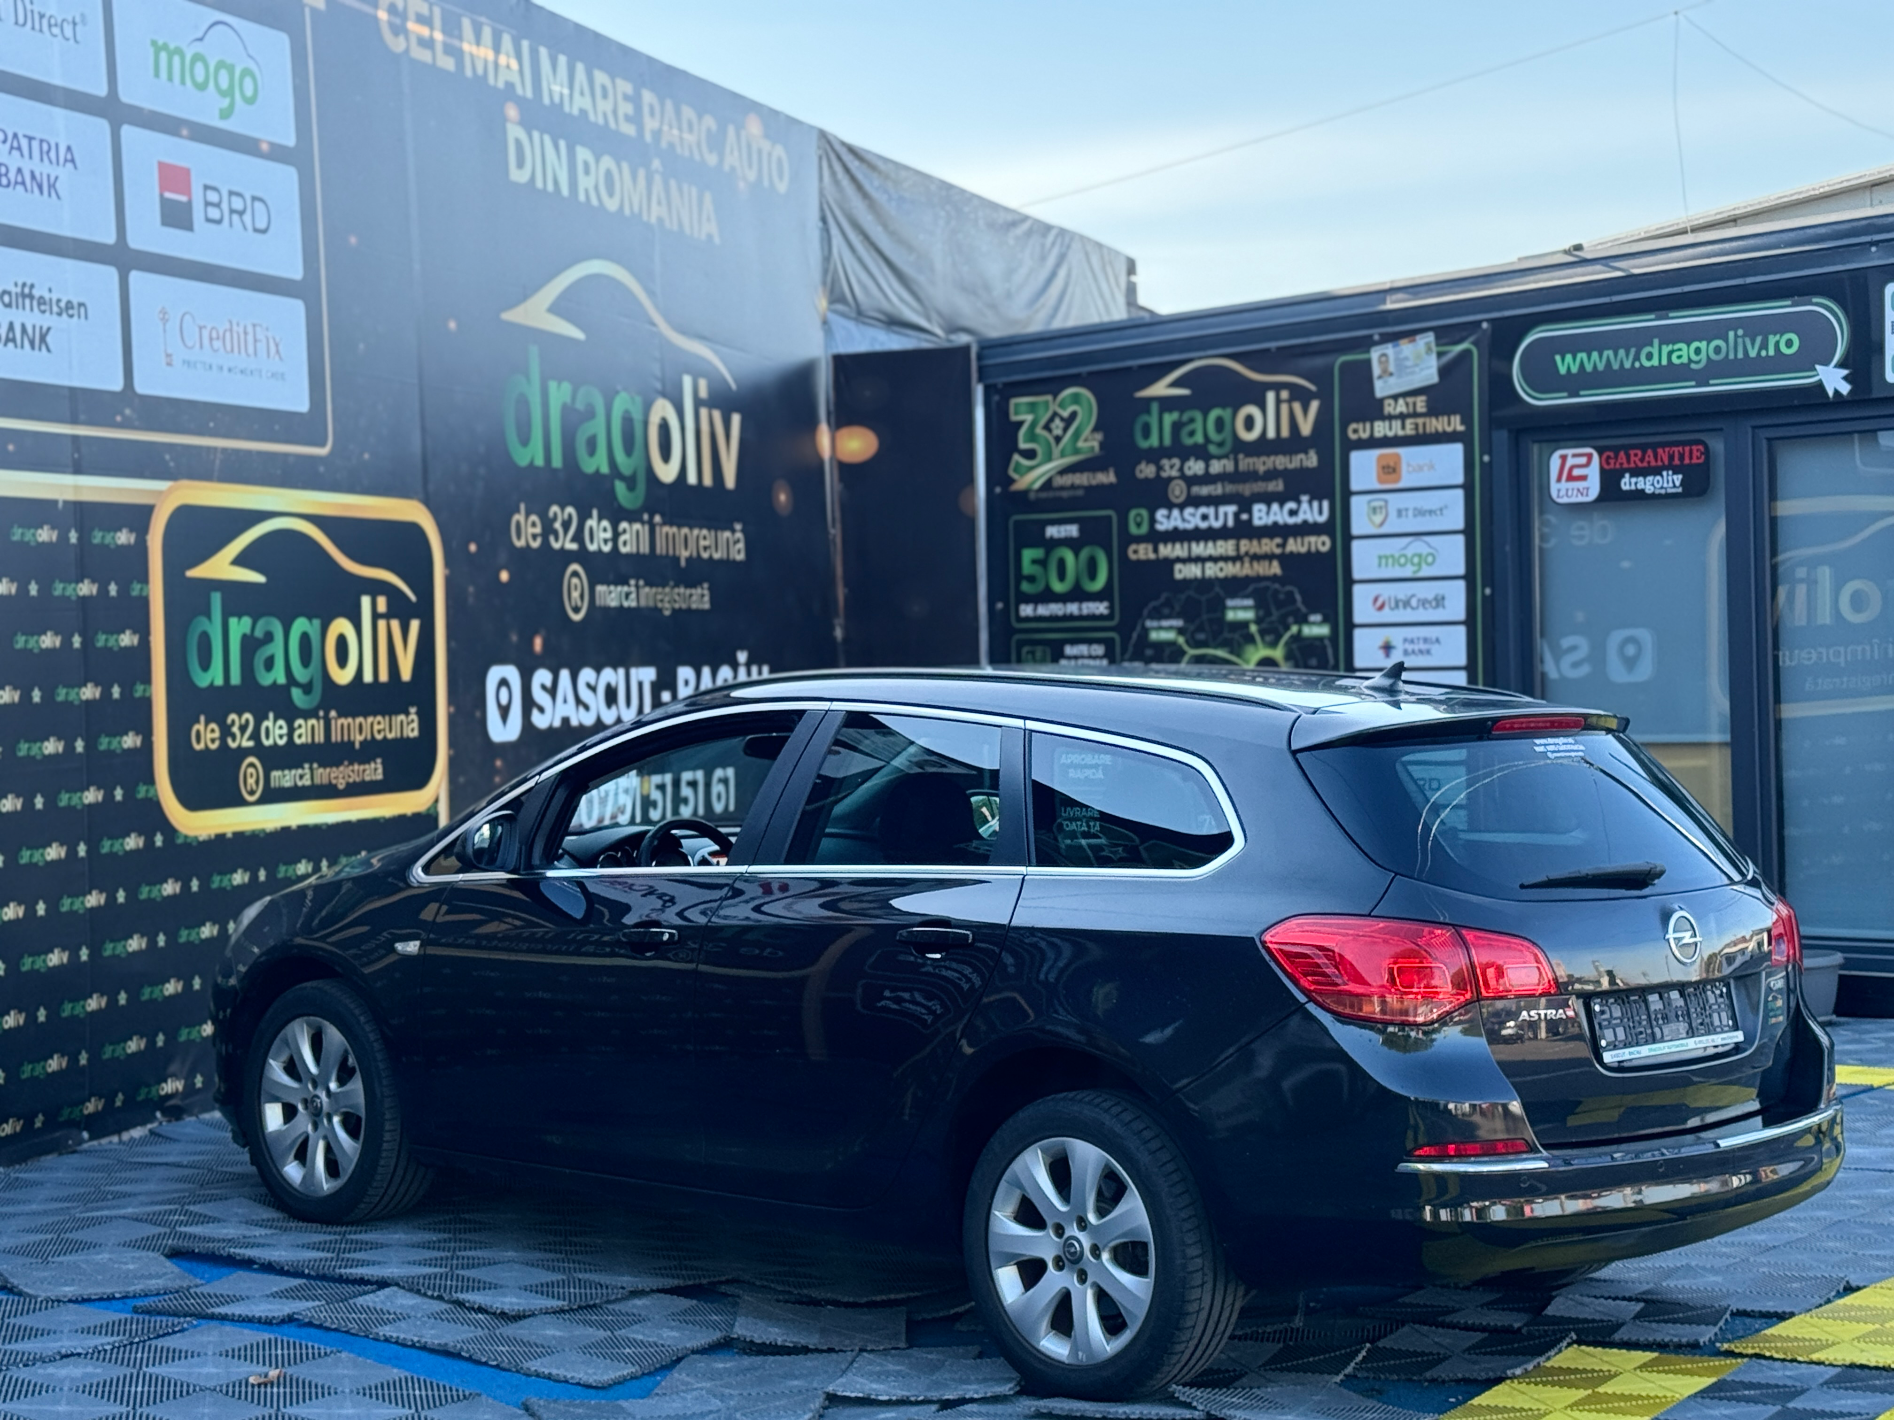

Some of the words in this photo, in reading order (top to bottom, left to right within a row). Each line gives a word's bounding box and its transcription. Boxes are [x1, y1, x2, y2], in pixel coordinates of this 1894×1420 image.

[150, 38, 259, 120] mogo
[377, 0, 456, 72] CEL
[462, 16, 533, 99] MAI
[539, 45, 636, 138] MARE
[641, 88, 719, 168] PARC
[724, 122, 790, 194] AUTO
[0, 164, 62, 200] BANK
[506, 121, 570, 197] DIN
[575, 144, 721, 245] ROMÂNIA
[203, 184, 271, 235] BRD
[0, 282, 89, 320] aiffeisen
[179, 312, 284, 362] CreditFix
[1554, 328, 1800, 376] www.dragoliv.ro
[1383, 396, 1428, 416] RATE
[504, 344, 741, 510] dragoliv
[1133, 390, 1320, 456] dragoliv
[1347, 421, 1371, 440] CU
[1373, 414, 1465, 438] BULETINUL
[1135, 460, 1157, 479] de
[1159, 458, 1181, 477] 32
[1186, 456, 1205, 476] de
[1208, 455, 1234, 475] ani
[1238, 449, 1318, 474] împreună
[1405, 460, 1437, 474] bank
[1555, 452, 1594, 483] 12
[1600, 444, 1705, 470] GARANTIE
[1556, 486, 1590, 500] LUNI
[1620, 470, 1683, 494] dragoliv
[1154, 504, 1238, 532] SASCUT
[1251, 495, 1330, 527] BACĂU
[1396, 507, 1411, 519] BT
[10, 524, 58, 546] dragoliv
[91, 528, 136, 549] dragoliv
[510, 502, 542, 548] de
[549, 504, 579, 551] 32
[584, 508, 613, 553] de
[617, 512, 650, 555] ani
[654, 513, 746, 568] împreună
[1045, 523, 1080, 539] PESTE
[1127, 543, 1156, 560] CEL
[1158, 541, 1189, 559] MAI
[1191, 539, 1237, 558] MARE
[1238, 537, 1283, 556] PARC
[1285, 535, 1331, 554] AUTO
[1019, 545, 1109, 594] 500
[1174, 562, 1203, 580] DIN
[1205, 557, 1282, 579] ROMÂNIA
[1377, 552, 1437, 575] mogo
[52, 579, 98, 600] dragoliv
[595, 579, 638, 608] marcă
[638, 580, 711, 616] înregistrată
[1081, 601, 1110, 616] STOC
[1387, 594, 1446, 612] UniCredit
[13, 631, 61, 653] dragoliv
[95, 630, 139, 650] dragoliv
[186, 591, 421, 709] dragoliv
[1402, 636, 1441, 647] PATRIA
[1402, 647, 1433, 658] BANK
[55, 682, 101, 704] dragoliv
[530, 665, 657, 729] SASCUT
[191, 716, 220, 750] de
[226, 712, 255, 748] 32
[260, 711, 288, 746] de
[293, 710, 324, 745] ani
[330, 707, 418, 749] împreună
[16, 737, 64, 759] dragoliv
[97, 732, 142, 753] dragoliv
[270, 761, 311, 788] marcă
[313, 758, 383, 789] înregistrată
[57, 786, 103, 809] dragoliv
[649, 773, 673, 821] 51
[679, 769, 704, 818] 51
[711, 767, 735, 814] 61
[18, 842, 67, 866] dragoliv
[100, 833, 144, 854] dragoliv
[59, 889, 106, 913] dragoliv
[138, 878, 181, 901] dragoliv
[101, 934, 147, 957] dragoliv
[20, 948, 69, 972] dragoliv
[60, 993, 107, 1018] dragoliv
[1518, 1008, 1567, 1021] ASTRA
[101, 1035, 147, 1059] dragoliv
[20, 1053, 68, 1079] dragoliv
